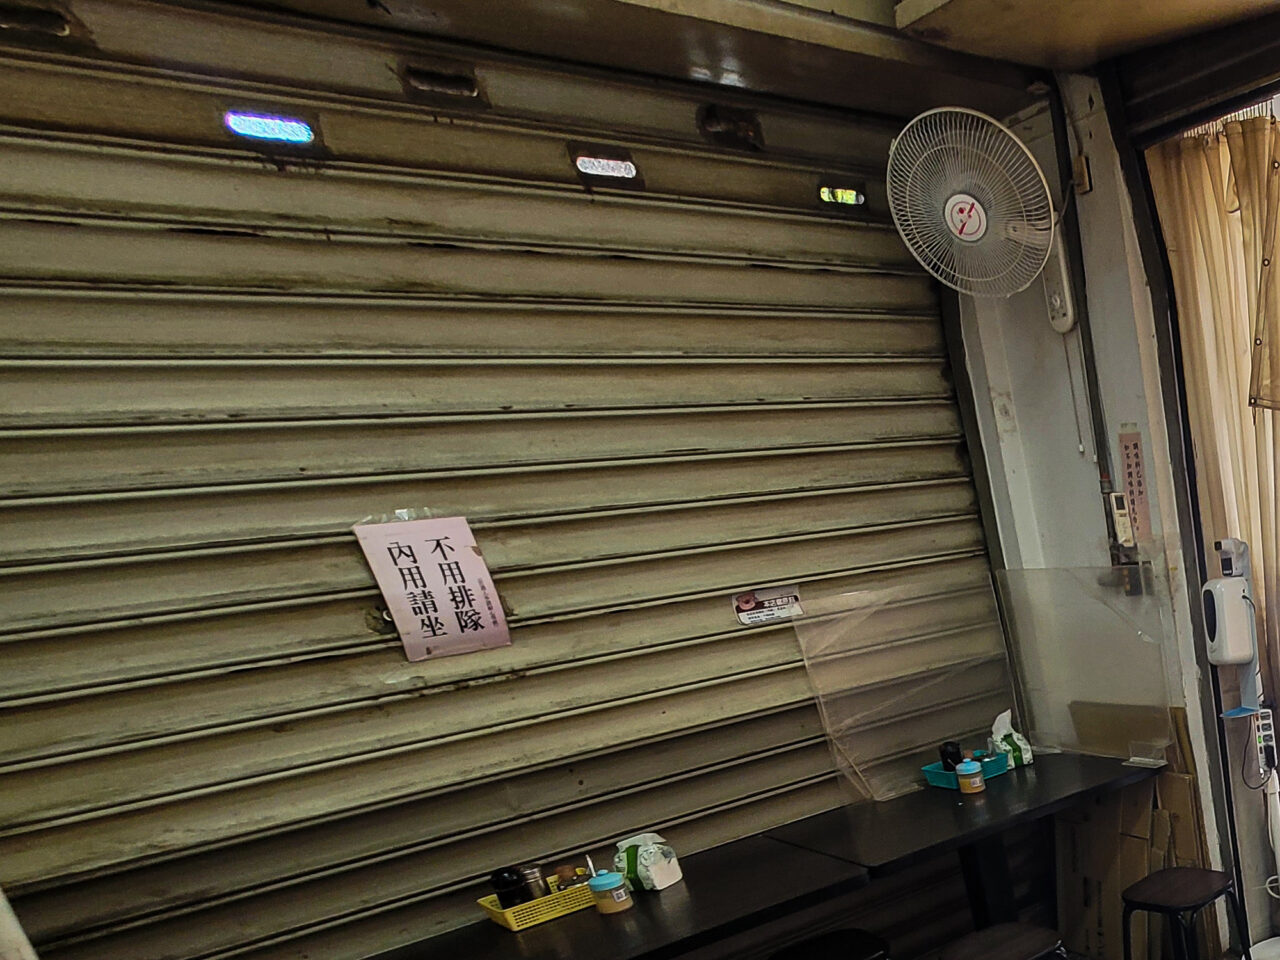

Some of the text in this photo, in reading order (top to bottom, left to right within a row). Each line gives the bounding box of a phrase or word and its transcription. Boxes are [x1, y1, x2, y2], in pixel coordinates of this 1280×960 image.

[386, 540, 449, 639] 內用請坐
[424, 536, 486, 634] 不用排隊
